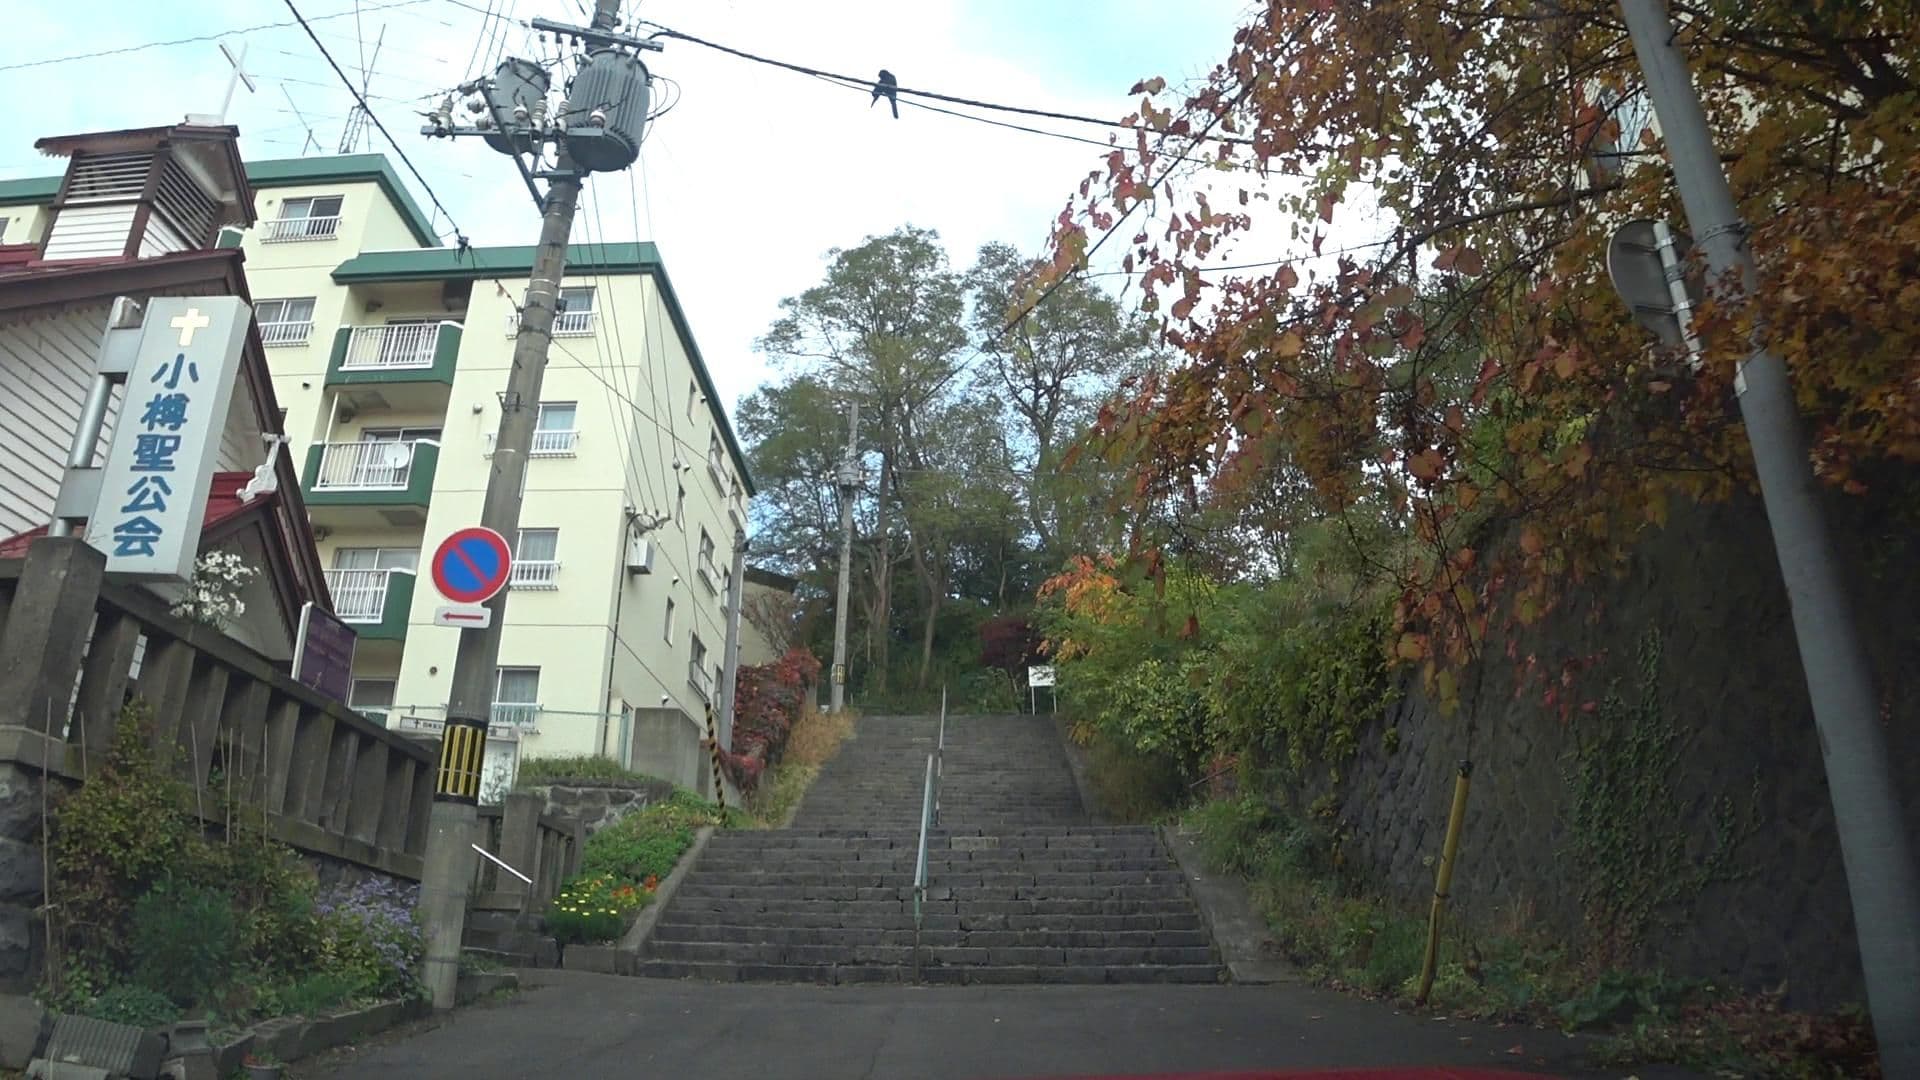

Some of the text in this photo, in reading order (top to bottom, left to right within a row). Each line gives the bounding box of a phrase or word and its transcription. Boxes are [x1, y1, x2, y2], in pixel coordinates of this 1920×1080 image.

[112, 353, 199, 557] 小樽聖公会
